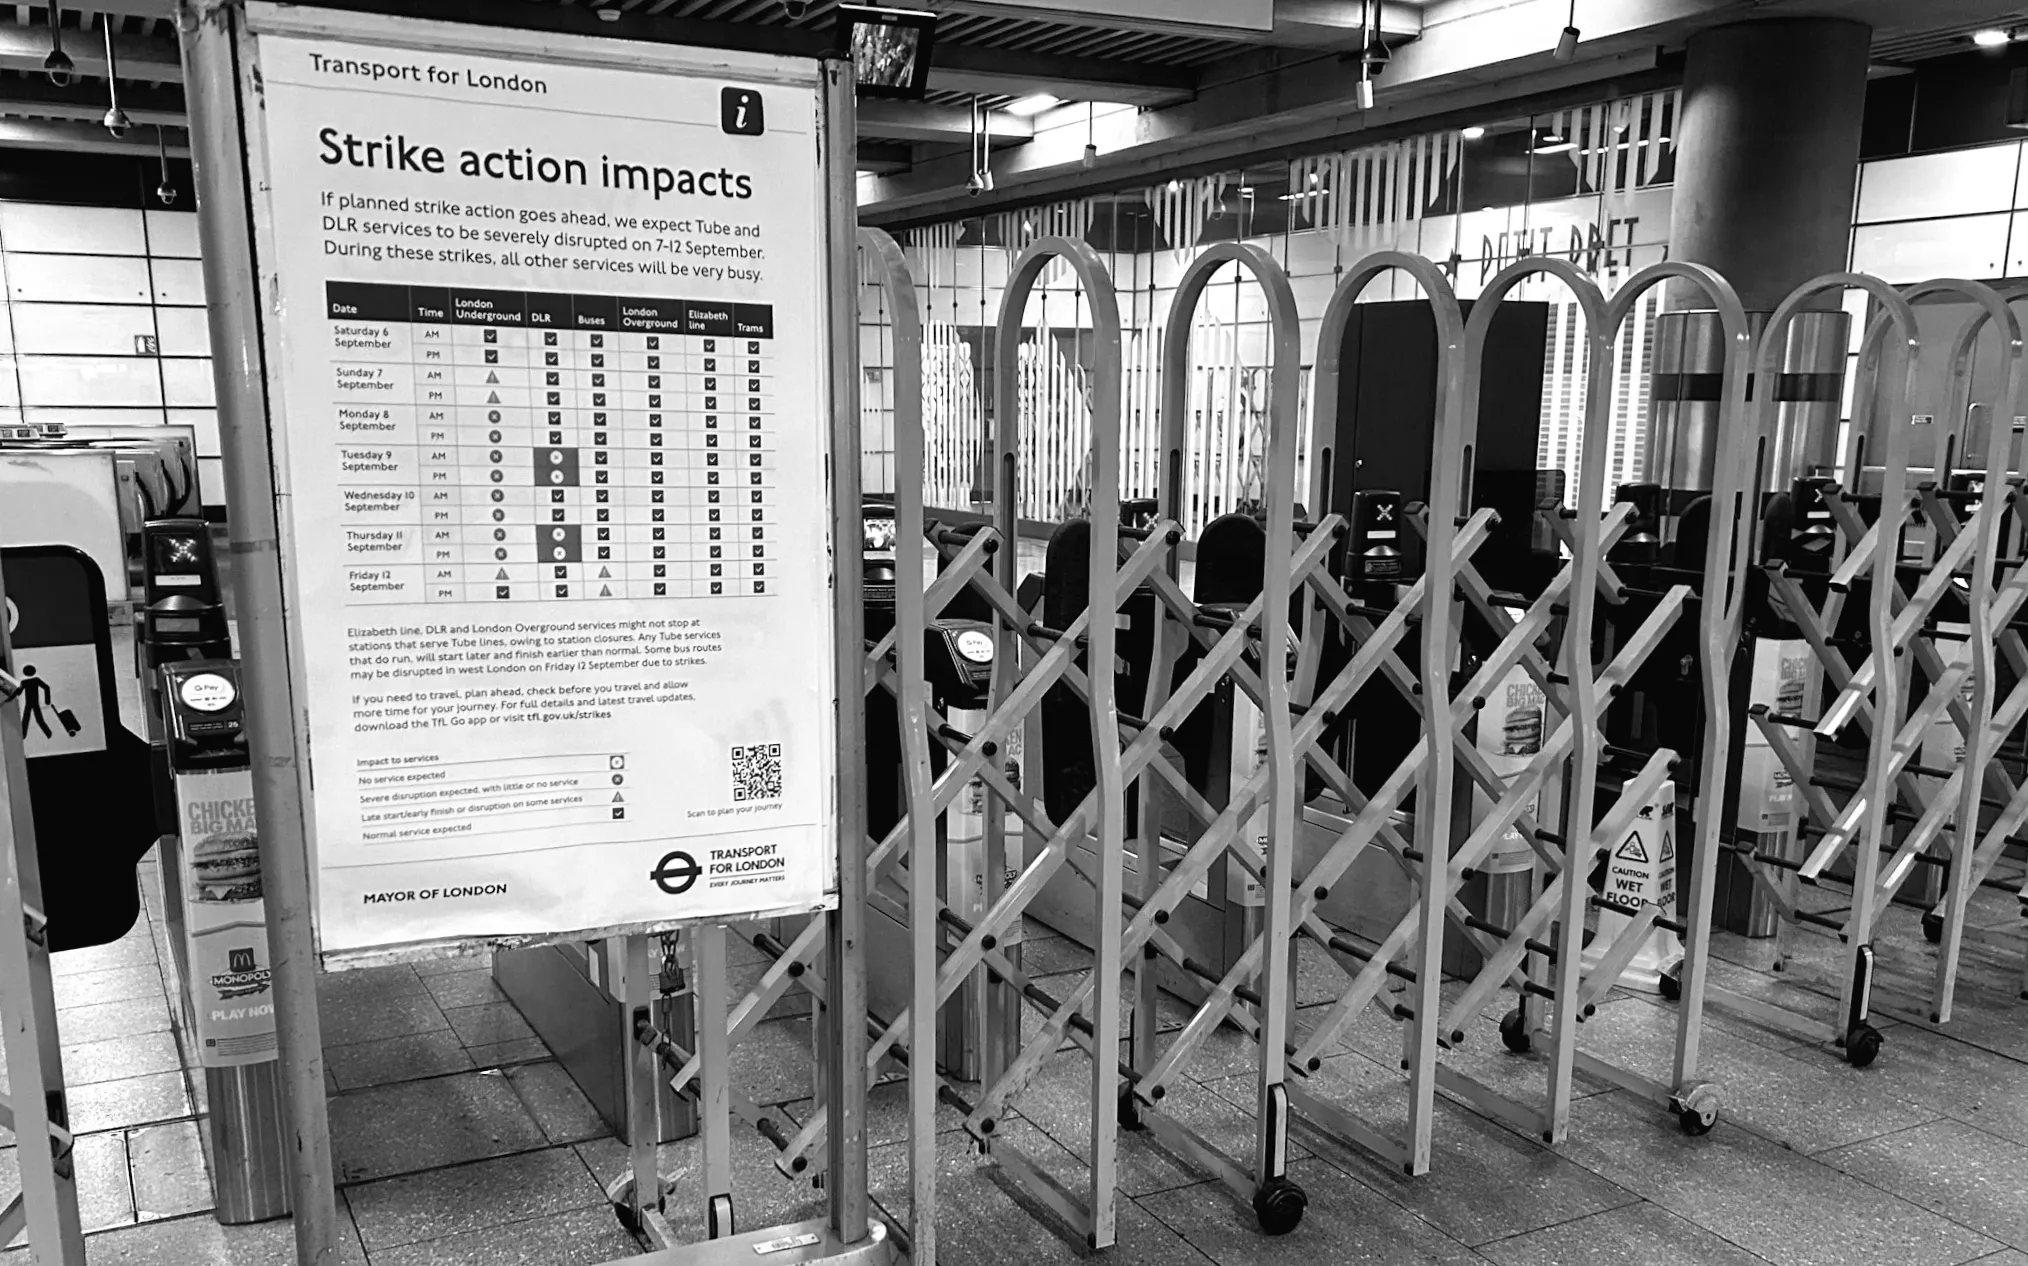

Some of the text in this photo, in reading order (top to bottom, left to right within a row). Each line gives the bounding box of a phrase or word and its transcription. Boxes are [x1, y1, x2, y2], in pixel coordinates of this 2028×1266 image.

[308, 52, 547, 94] Transport for London
[319, 127, 752, 201] Strike action impacts
[321, 191, 760, 238] If planned strike action goes ahead, we expect Tube and
[322, 215, 358, 233] DLR
[363, 221, 432, 238] services
[435, 224, 455, 239] to
[459, 224, 480, 241] be
[483, 230, 550, 249] severely
[553, 231, 628, 252] disrupted
[631, 240, 652, 252] on
[685, 240, 765, 260] September.
[324, 239, 763, 284] During these strikes, all other services will be very busy.
[332, 302, 358, 314] Date
[455, 297, 494, 309] London
[417, 307, 444, 318] Time
[455, 309, 522, 322] Underground
[531, 312, 552, 323] DLR
[622, 306, 659, 317] London
[688, 309, 729, 321] Elizabeth
[577, 314, 606, 326] Buses
[622, 316, 679, 330] Overground
[688, 320, 706, 331] line
[334, 325, 389, 339] Saturday 6
[737, 322, 764, 333] Trams
[424, 330, 440, 339] AM
[334, 337, 392, 349] September
[426, 350, 441, 359] PM
[336, 367, 383, 380] Sunday 7
[426, 371, 442, 380] AM
[336, 378, 395, 391] September
[428, 391, 443, 400] PM
[338, 409, 390, 421] Monday 8
[428, 411, 444, 420] AM
[339, 420, 397, 432] September
[430, 431, 445, 440] PM
[340, 449, 392, 462] Tuesday 9
[341, 461, 399, 473] September
[343, 490, 415, 502] Wednesday 10
[344, 502, 401, 513] September
[346, 530, 403, 542] Thursday 11
[347, 542, 403, 553] September
[349, 570, 391, 582] Friday 12
[349, 581, 405, 593] September
[347, 627, 398, 638] Elizabeth
[425, 624, 448, 635] DLR
[449, 624, 470, 635] and
[471, 624, 513, 634] London
[514, 621, 576, 635] Overground
[577, 621, 617, 631] services
[618, 619, 647, 631] might
[648, 620, 666, 629] not
[667, 619, 690, 629] stop
[690, 619, 701, 627] at
[348, 642, 393, 652] stations
[394, 640, 417, 650] that
[419, 640, 449, 649] serve
[451, 637, 477, 648] Tube
[509, 637, 542, 648] owing
[543, 637, 556, 646] to
[557, 636, 592, 645] station
[637, 632, 657, 644] Any
[658, 631, 683, 641] Tube
[684, 631, 722, 641] services
[354, 719, 409, 733] download
[410, 719, 429, 729] the
[450, 716, 466, 726] Go
[467, 716, 488, 726] app
[489, 715, 501, 724] or
[503, 713, 525, 723] visit
[356, 755, 440, 768] Impact to services
[358, 770, 446, 785] No service expected
[188, 799, 256, 820] CHICKE
[687, 803, 783, 819] Scan to plan your journey
[190, 816, 256, 834] BIG MA
[362, 822, 472, 840] Normal service expected
[709, 843, 778, 861] TRANSPORT
[709, 857, 785, 875] FOR LONDON
[1612, 866, 1650, 880] CAUTION
[709, 874, 786, 889] EVERY JOURNEY MATTERS
[1616, 878, 1643, 893] WET
[363, 883, 507, 905] MAYOR OF LONDON
[212, 1007, 246, 1021] PLAY
